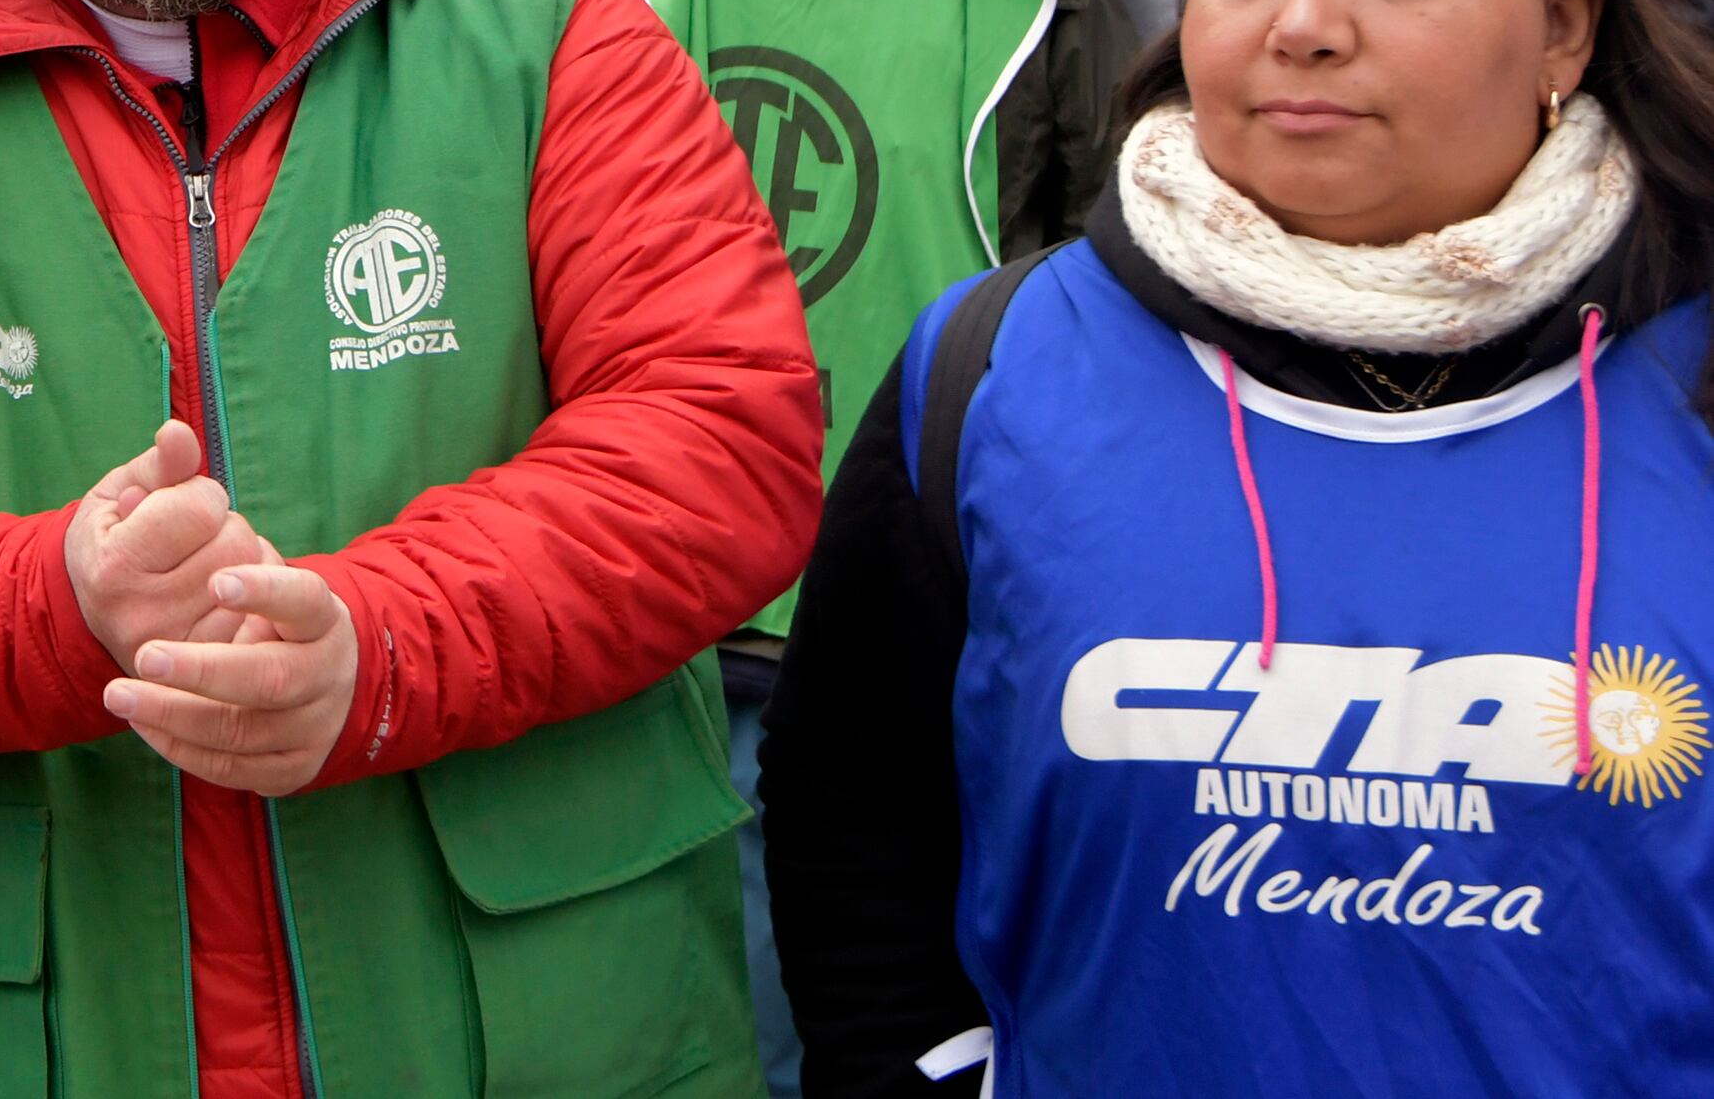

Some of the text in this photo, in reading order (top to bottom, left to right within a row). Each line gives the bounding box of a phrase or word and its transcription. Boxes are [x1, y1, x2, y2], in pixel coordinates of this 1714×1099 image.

[421, 224, 441, 252] DEL
[342, 225, 428, 326] ATE
[428, 254, 447, 309] ESTADO
[329, 336, 367, 350] CONSEJO
[408, 318, 456, 334] PROVINCIAL
[329, 331, 460, 371] MENDOZA
[1060, 638, 1578, 787] CTA
[1194, 768, 1495, 833] AUTONOMA
[1164, 822, 1542, 936] Mendoza
